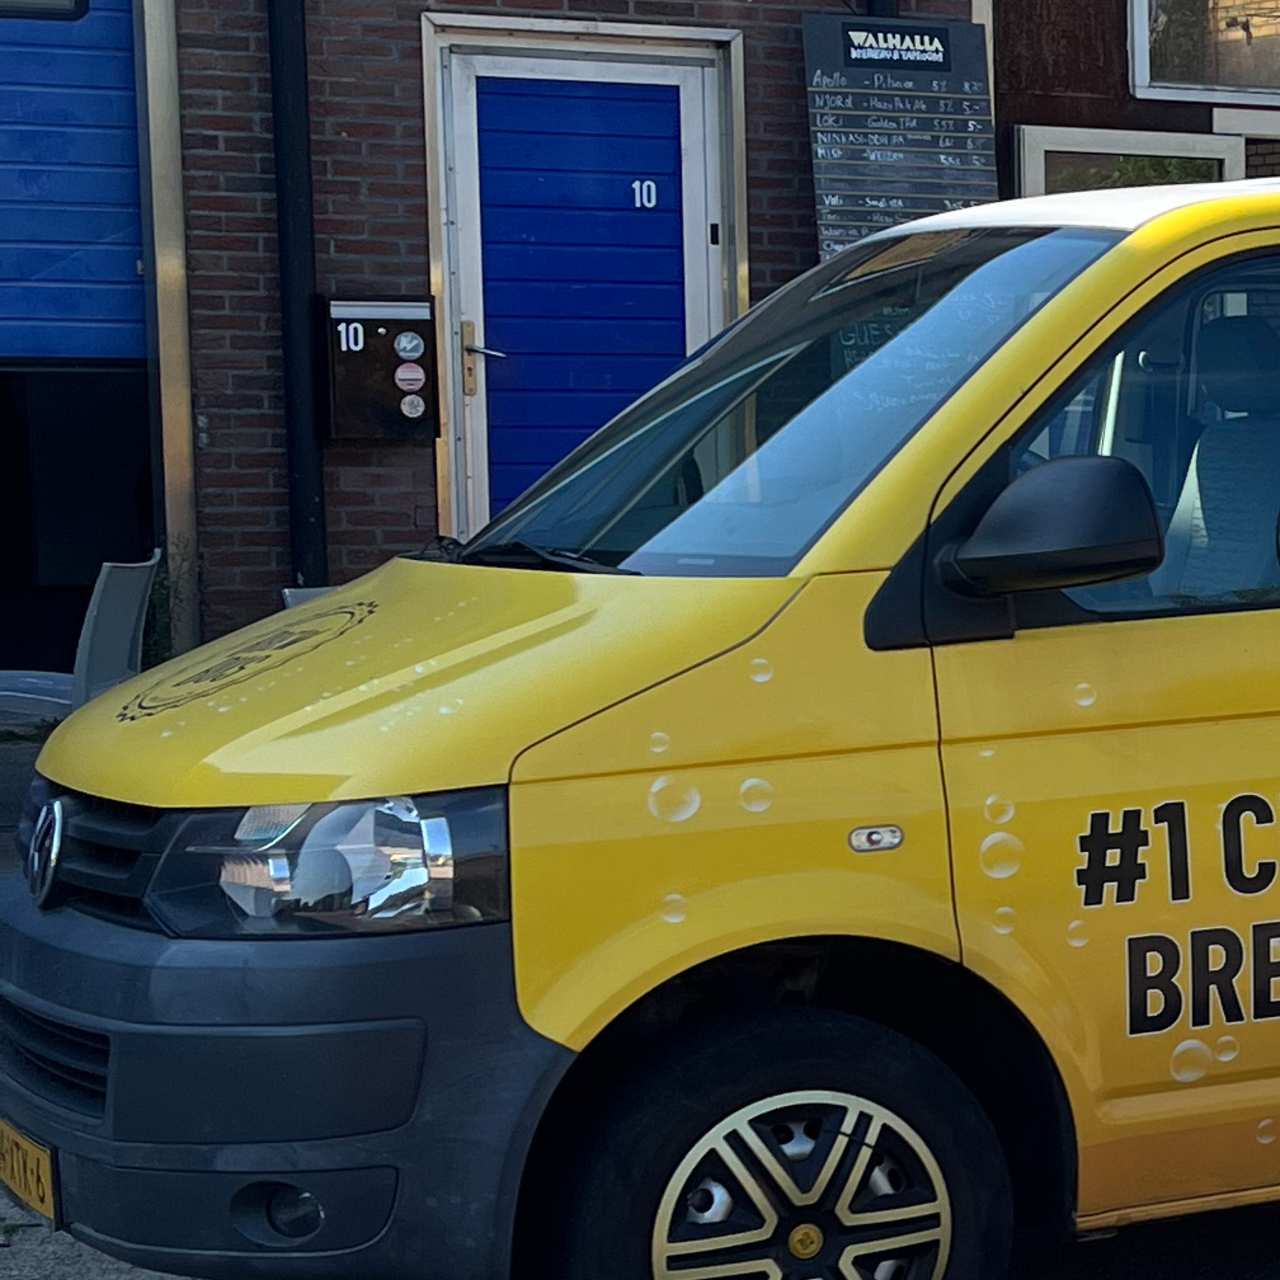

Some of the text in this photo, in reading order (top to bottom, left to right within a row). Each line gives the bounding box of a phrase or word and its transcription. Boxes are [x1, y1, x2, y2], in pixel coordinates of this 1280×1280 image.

[848, 30, 944, 51] WALHALLA
[631, 180, 657, 208] 10
[337, 322, 364, 351] 10
[1073, 800, 1192, 908] #1
